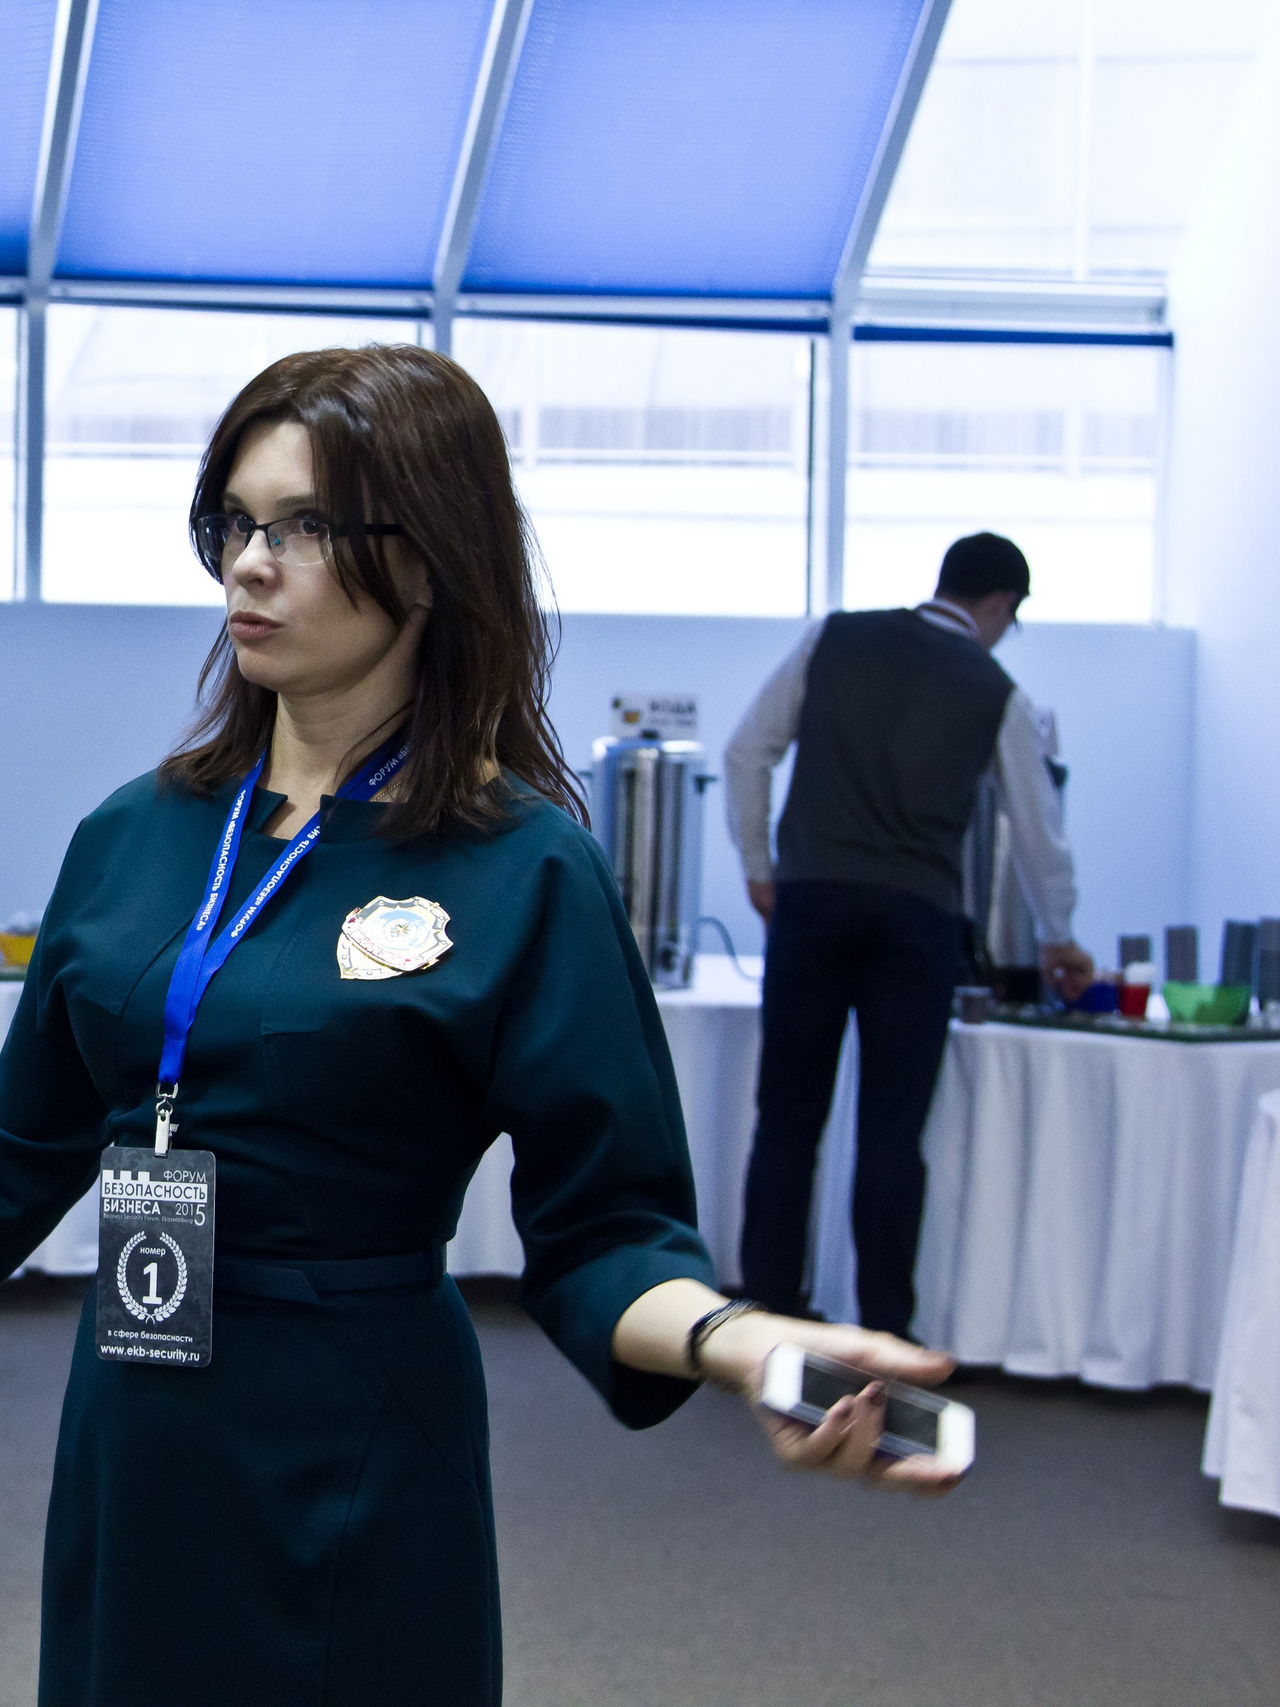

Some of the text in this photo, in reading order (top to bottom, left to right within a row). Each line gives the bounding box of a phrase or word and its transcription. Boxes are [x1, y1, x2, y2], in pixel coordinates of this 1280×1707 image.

[368, 757, 399, 786] ФОРУМ
[231, 905, 257, 938] ФОРУМ
[163, 1170, 207, 1183] ФОРУМ
[104, 1182, 206, 1200] БЕЗОПАСНОСТЬ
[103, 1199, 206, 1226] БИЗНЕСА 2015
[140, 1246, 166, 1257] номер
[142, 1262, 163, 1305] 1
[113, 1329, 139, 1339] сфере
[140, 1331, 193, 1343] безопасности
[100, 1344, 200, 1363] www.ekb-security.ru
